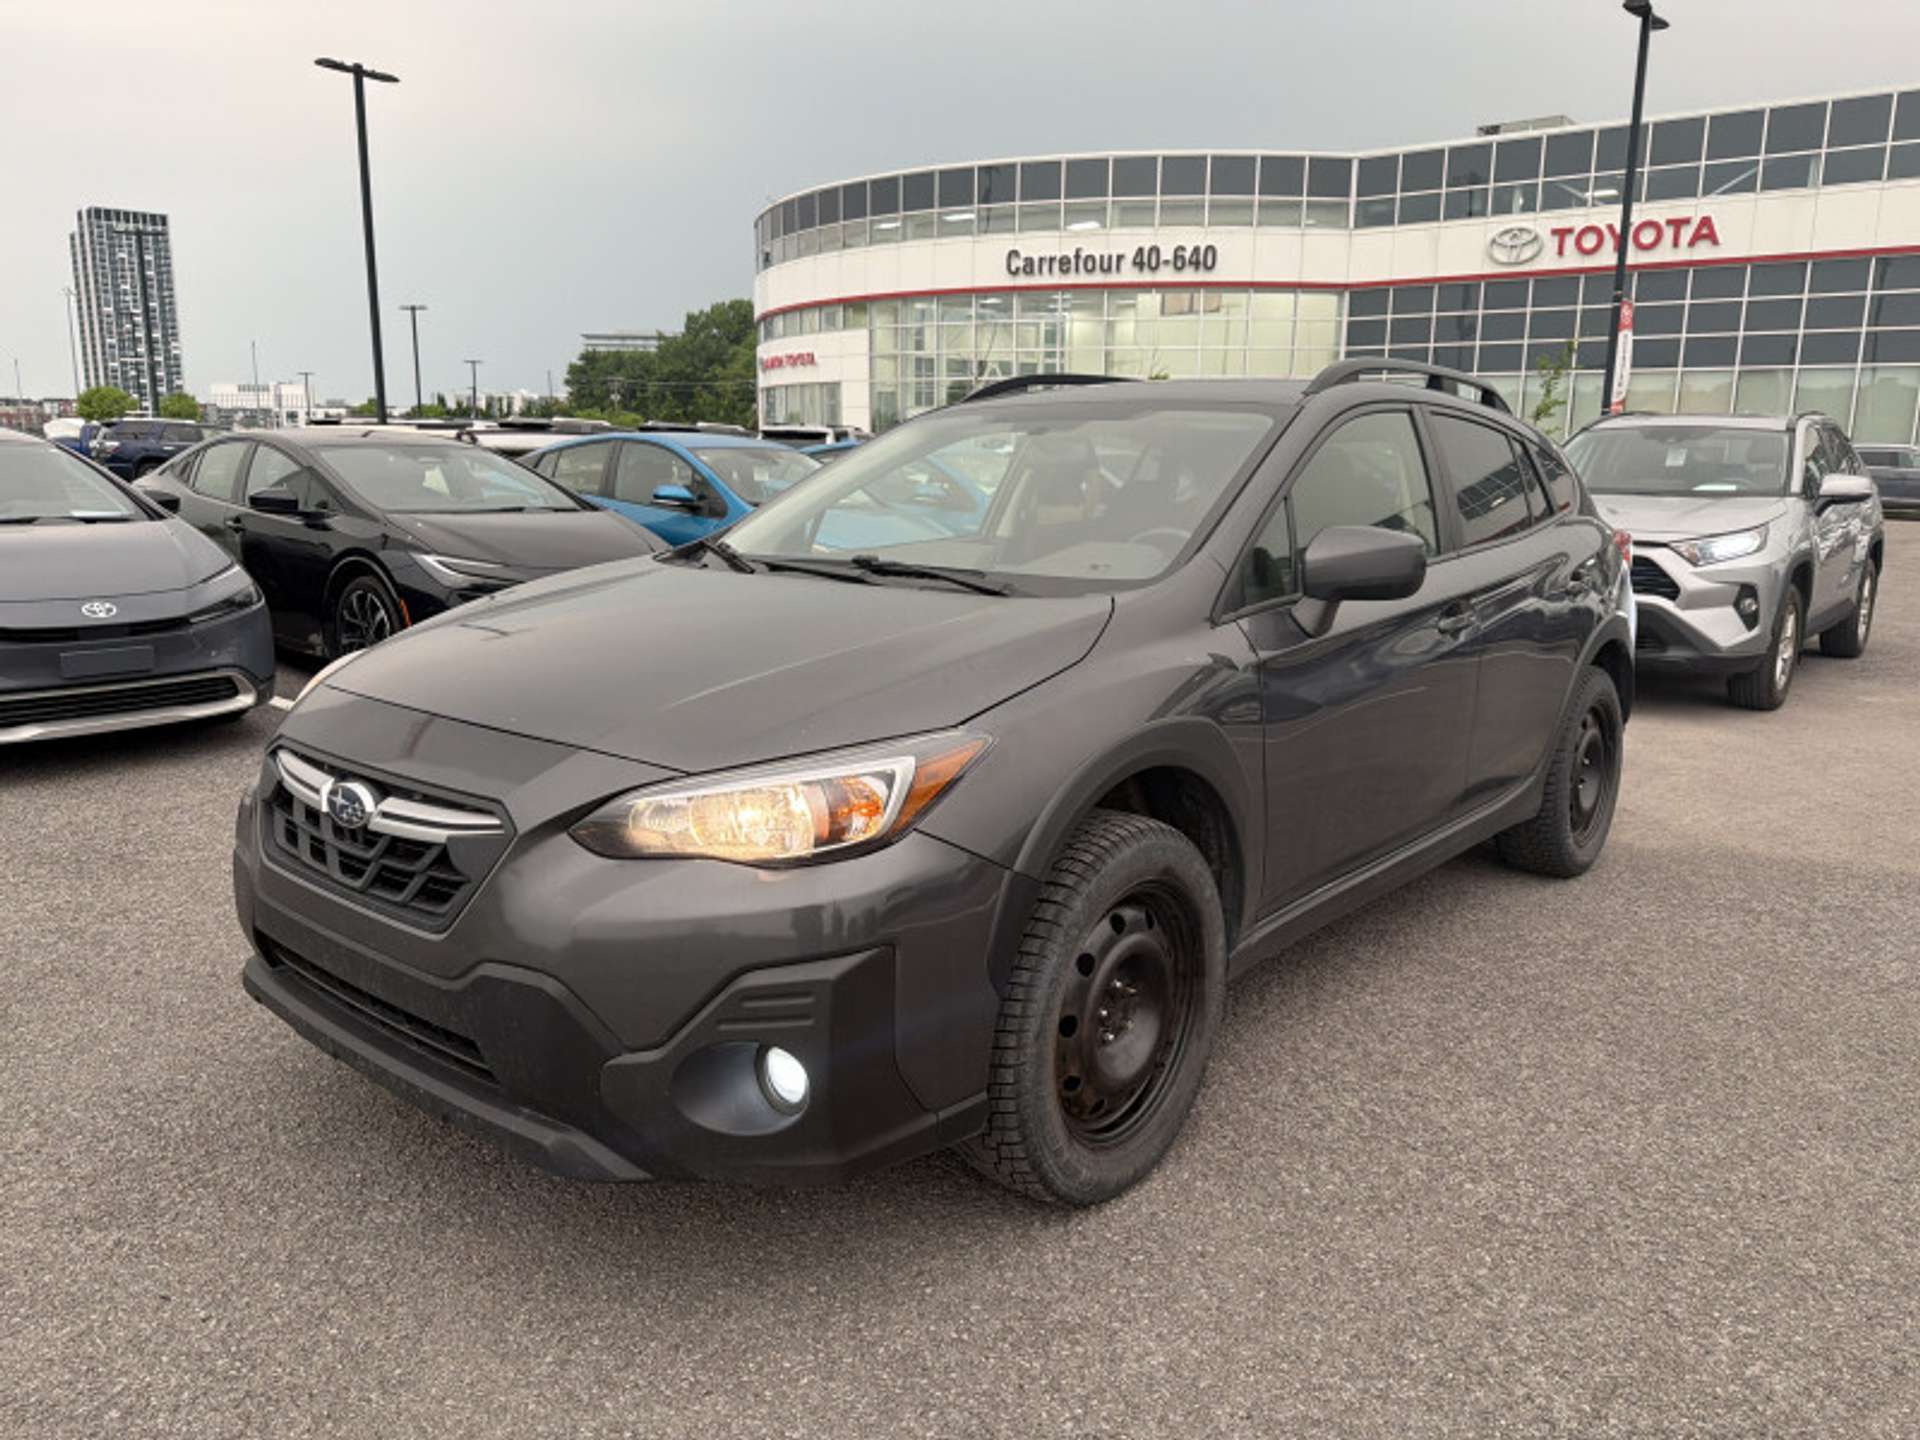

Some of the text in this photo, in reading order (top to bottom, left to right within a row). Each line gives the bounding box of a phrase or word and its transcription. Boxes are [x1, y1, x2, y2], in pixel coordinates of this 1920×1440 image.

[1551, 215, 1720, 257] TOYOTA
[1006, 245, 1218, 275] Carrefour 40-640
